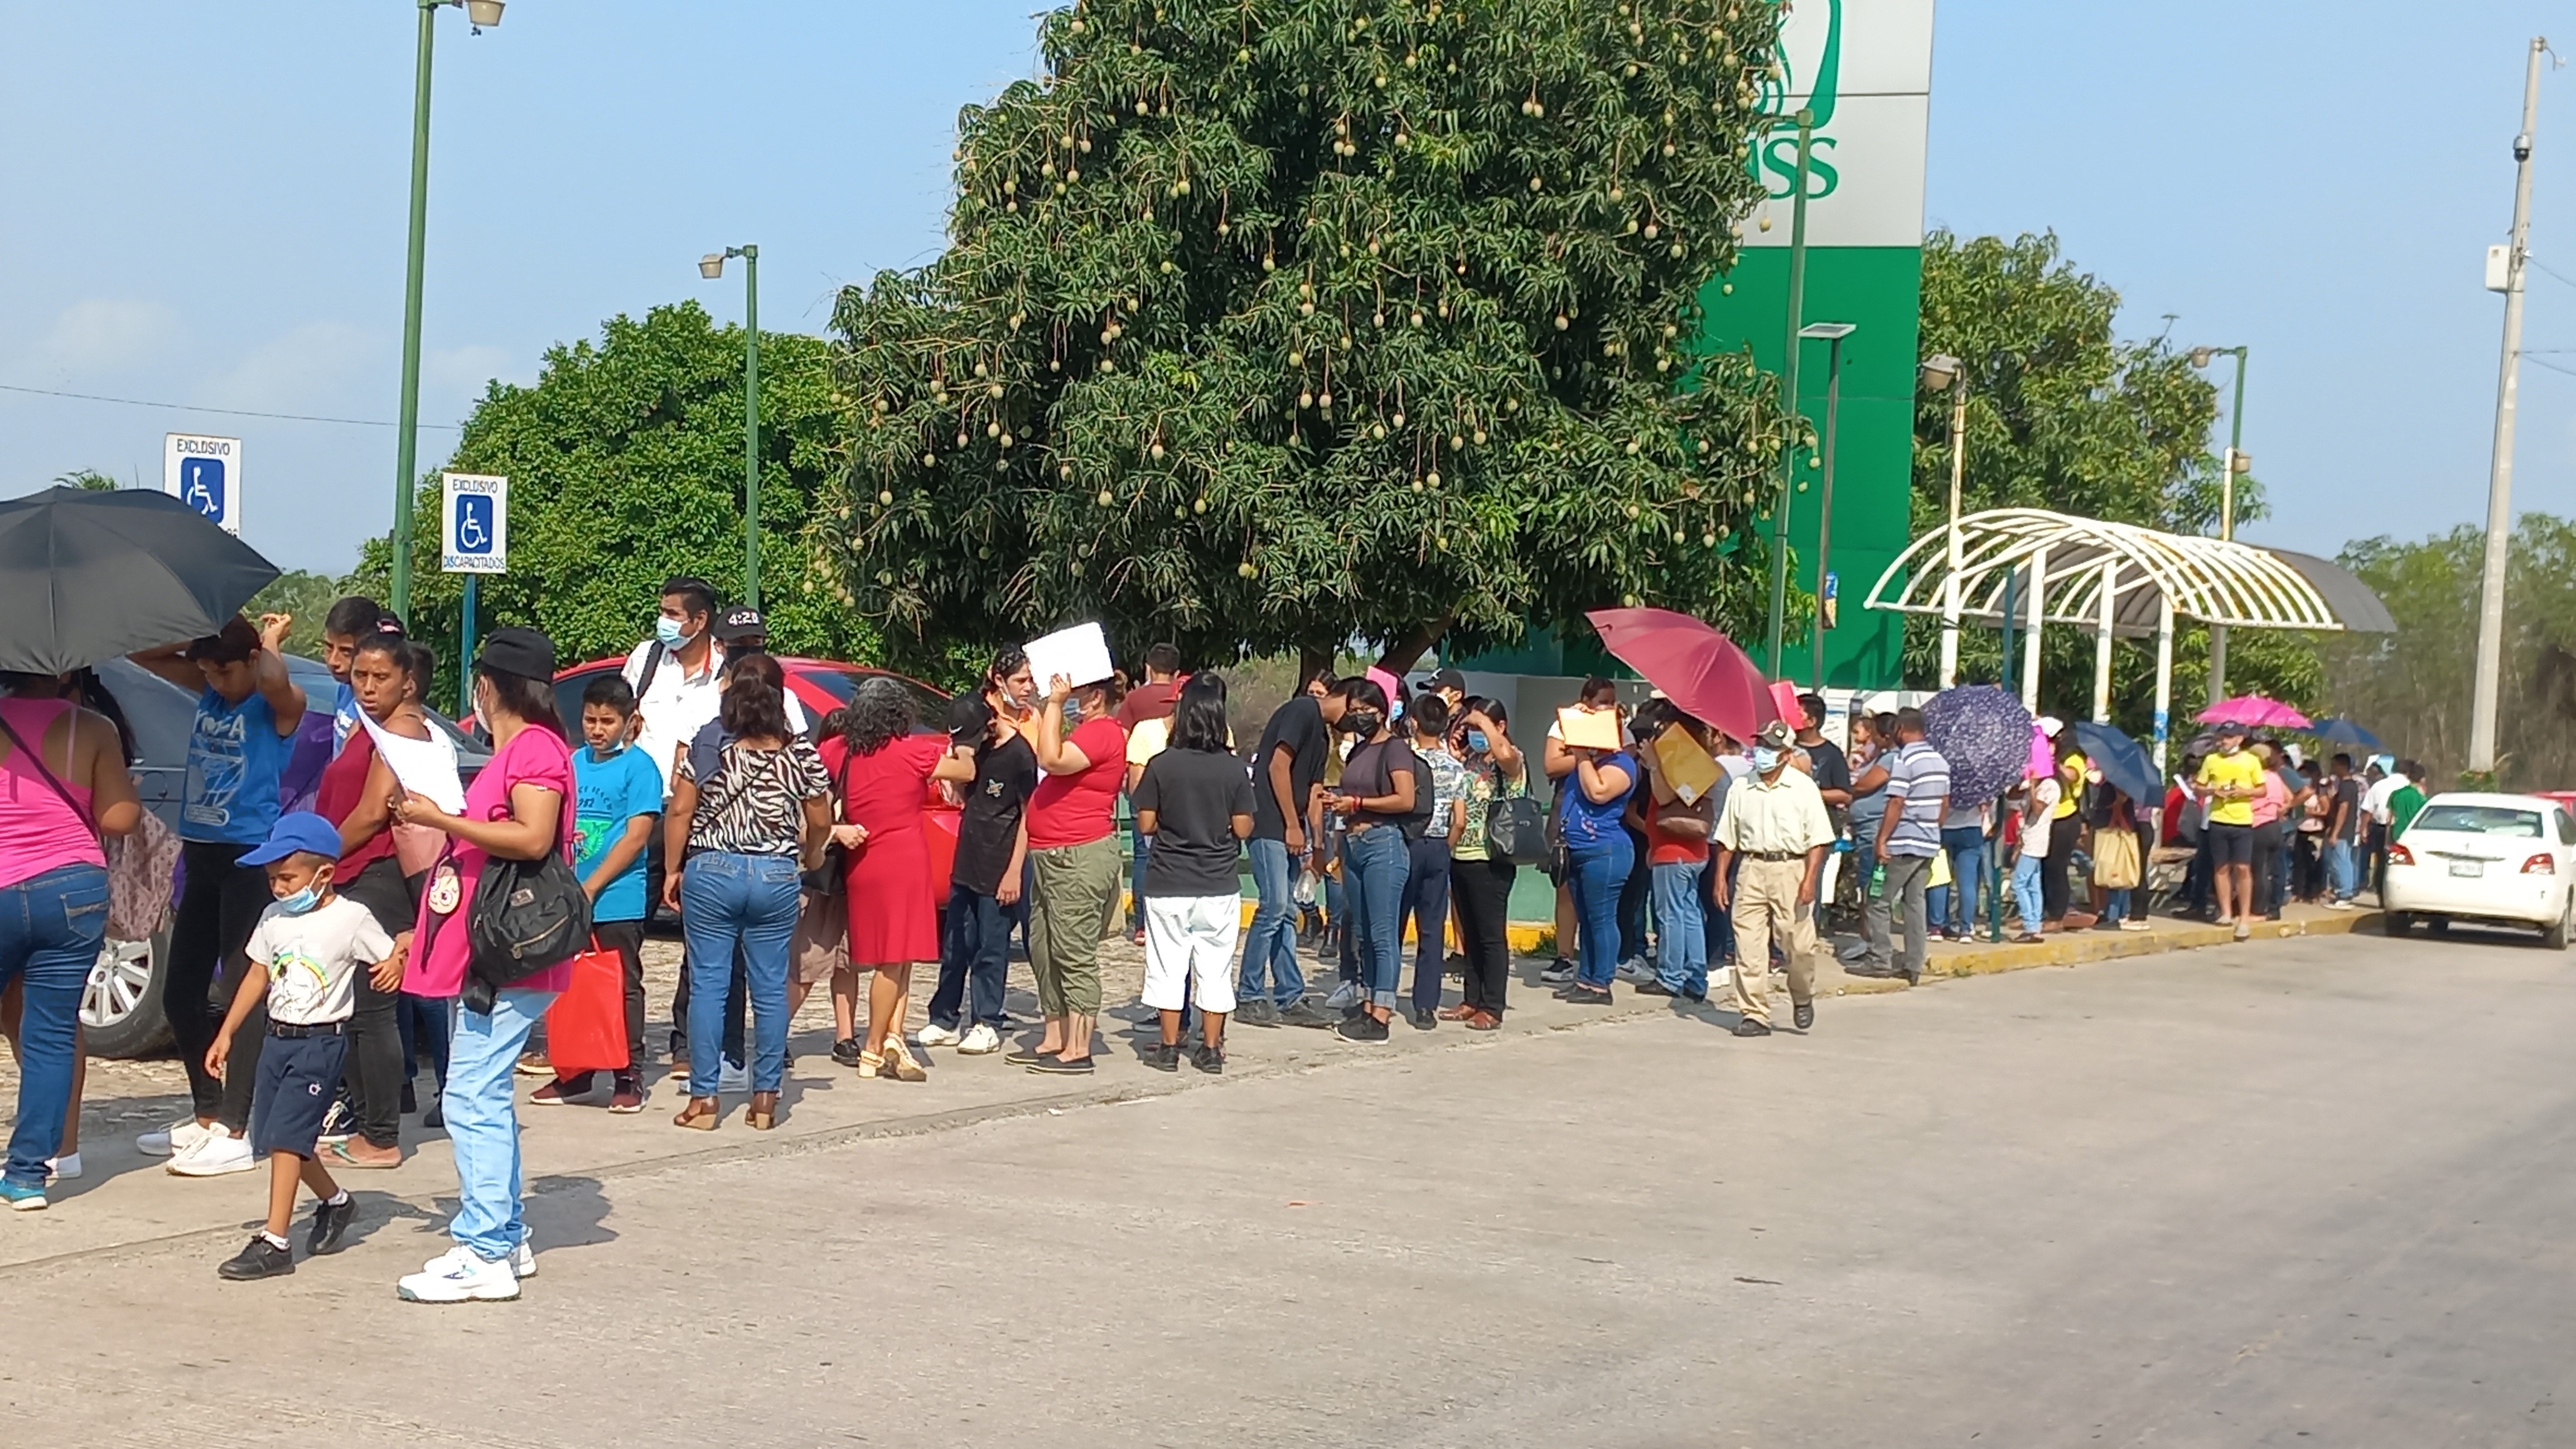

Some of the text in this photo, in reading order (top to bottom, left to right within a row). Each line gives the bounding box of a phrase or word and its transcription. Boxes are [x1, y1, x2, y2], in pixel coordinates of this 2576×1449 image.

[177, 439, 230, 455] EXCLUSIVO
[453, 479, 498, 493] EXCLUSIVO
[443, 555, 505, 569] DISCAPACITADOS
